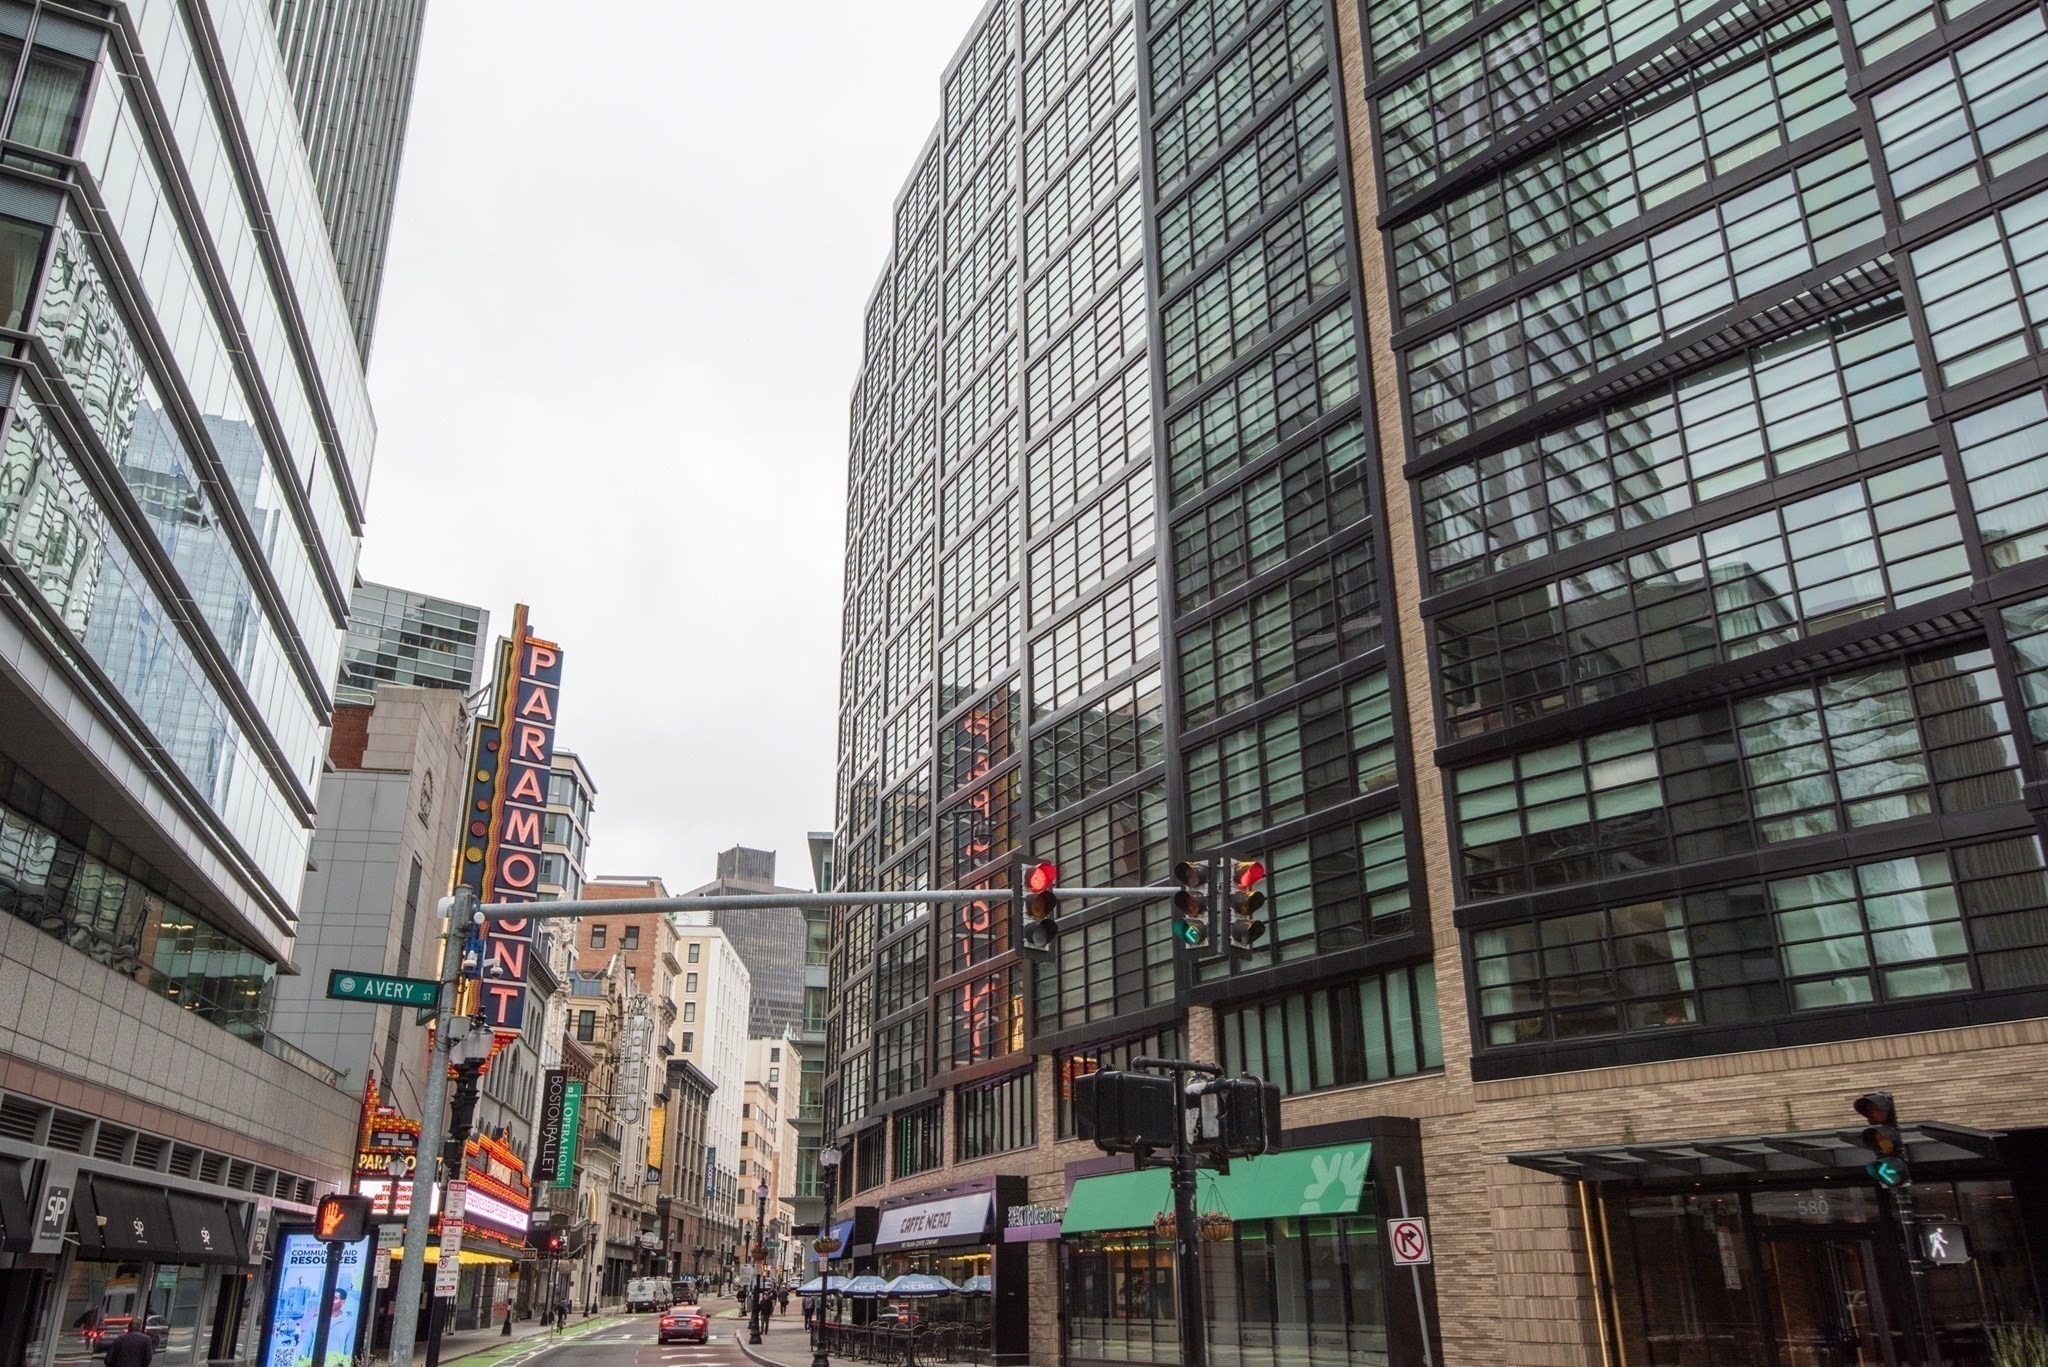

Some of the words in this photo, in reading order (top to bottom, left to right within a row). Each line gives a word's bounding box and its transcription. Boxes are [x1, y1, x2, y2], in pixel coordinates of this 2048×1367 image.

[490, 646, 557, 1024] PARAMOUNT
[364, 980, 414, 999] AVERY
[423, 993, 432, 1001] ST
[560, 1106, 574, 1145] OPERA
[556, 1146, 568, 1185] HOUSE
[925, 1211, 952, 1231] NERO
[1798, 1200, 1829, 1215] 580
